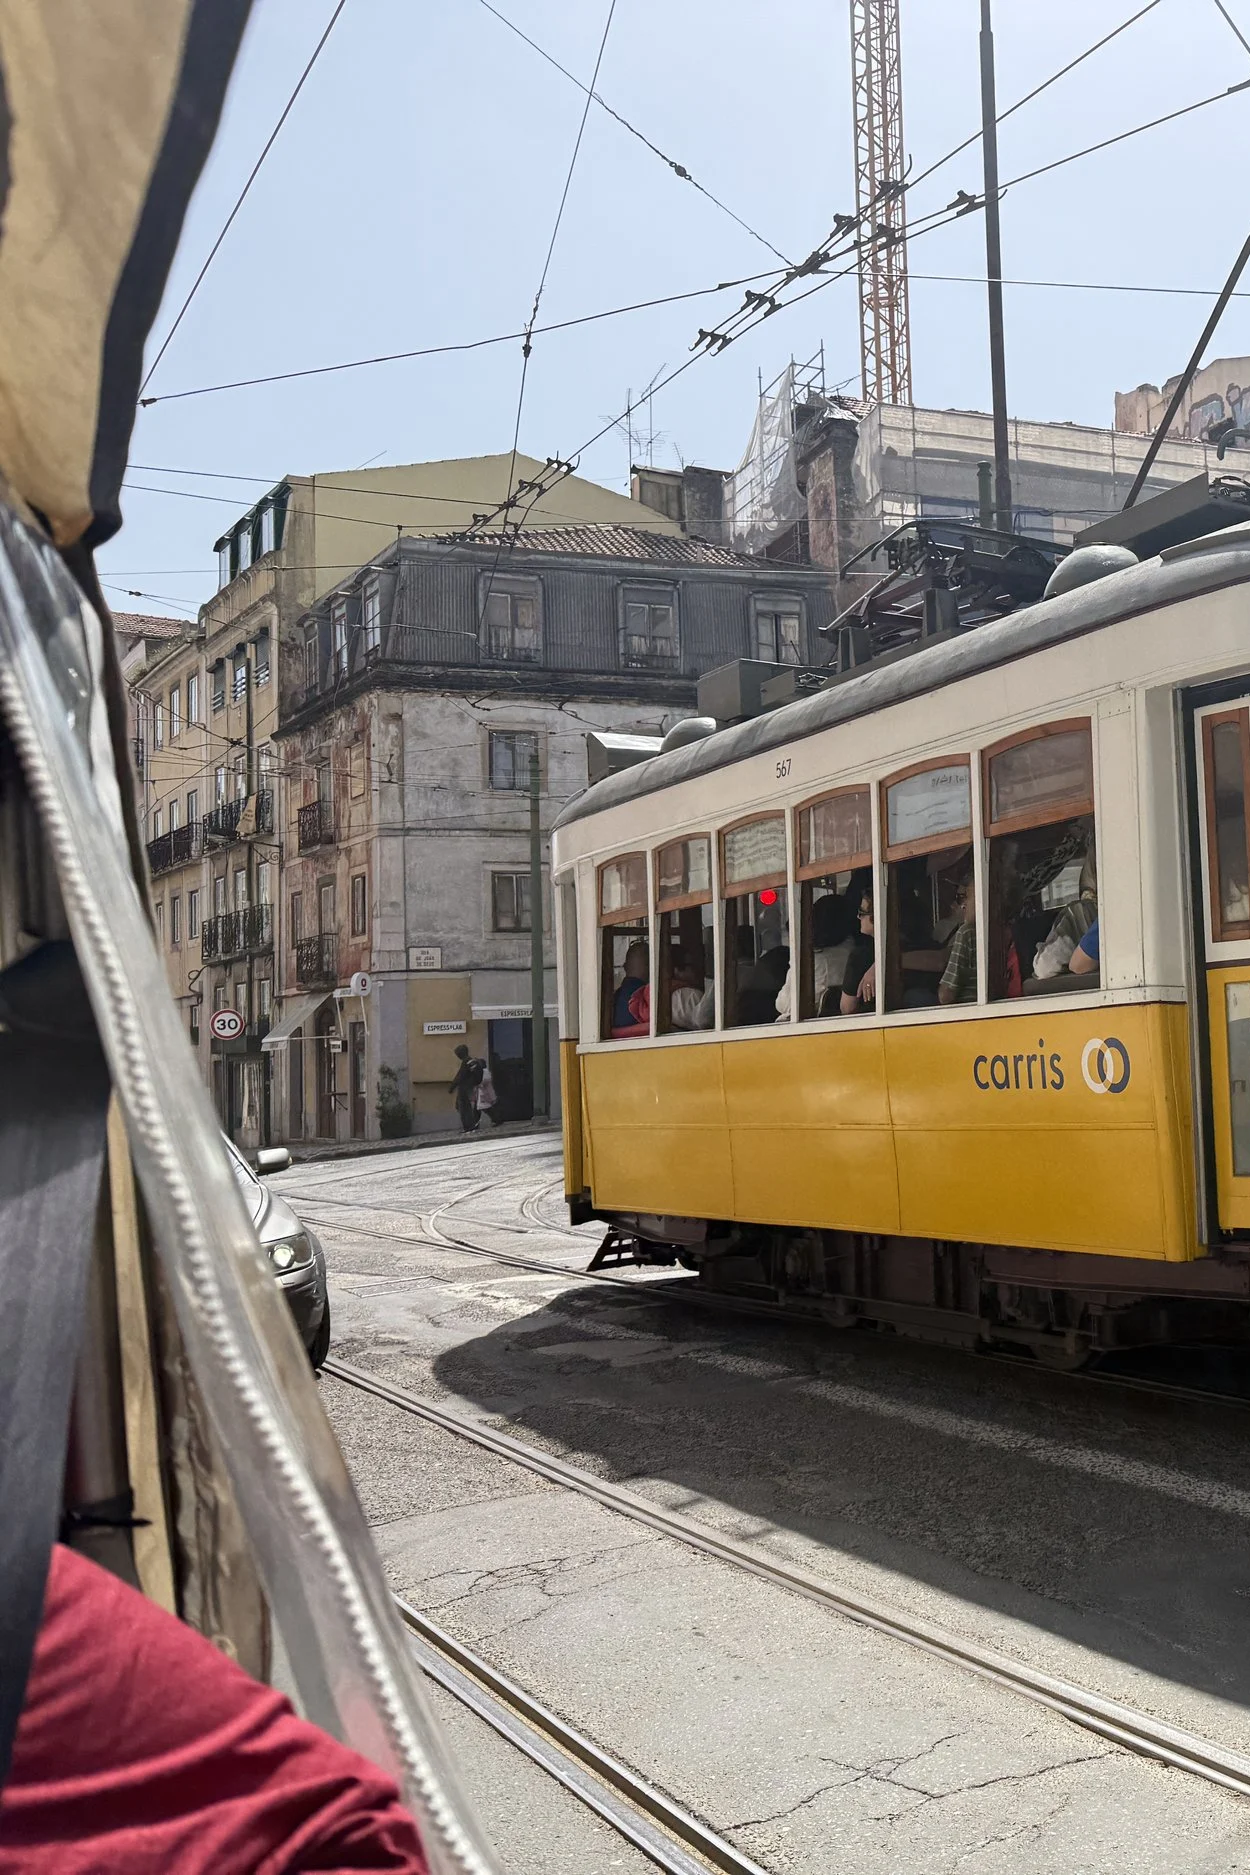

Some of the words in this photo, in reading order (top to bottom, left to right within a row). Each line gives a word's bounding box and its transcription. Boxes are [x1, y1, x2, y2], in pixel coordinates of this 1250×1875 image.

[776, 758, 792, 779] 567
[216, 1018, 238, 1031] 30
[973, 1038, 1064, 1090] carris
